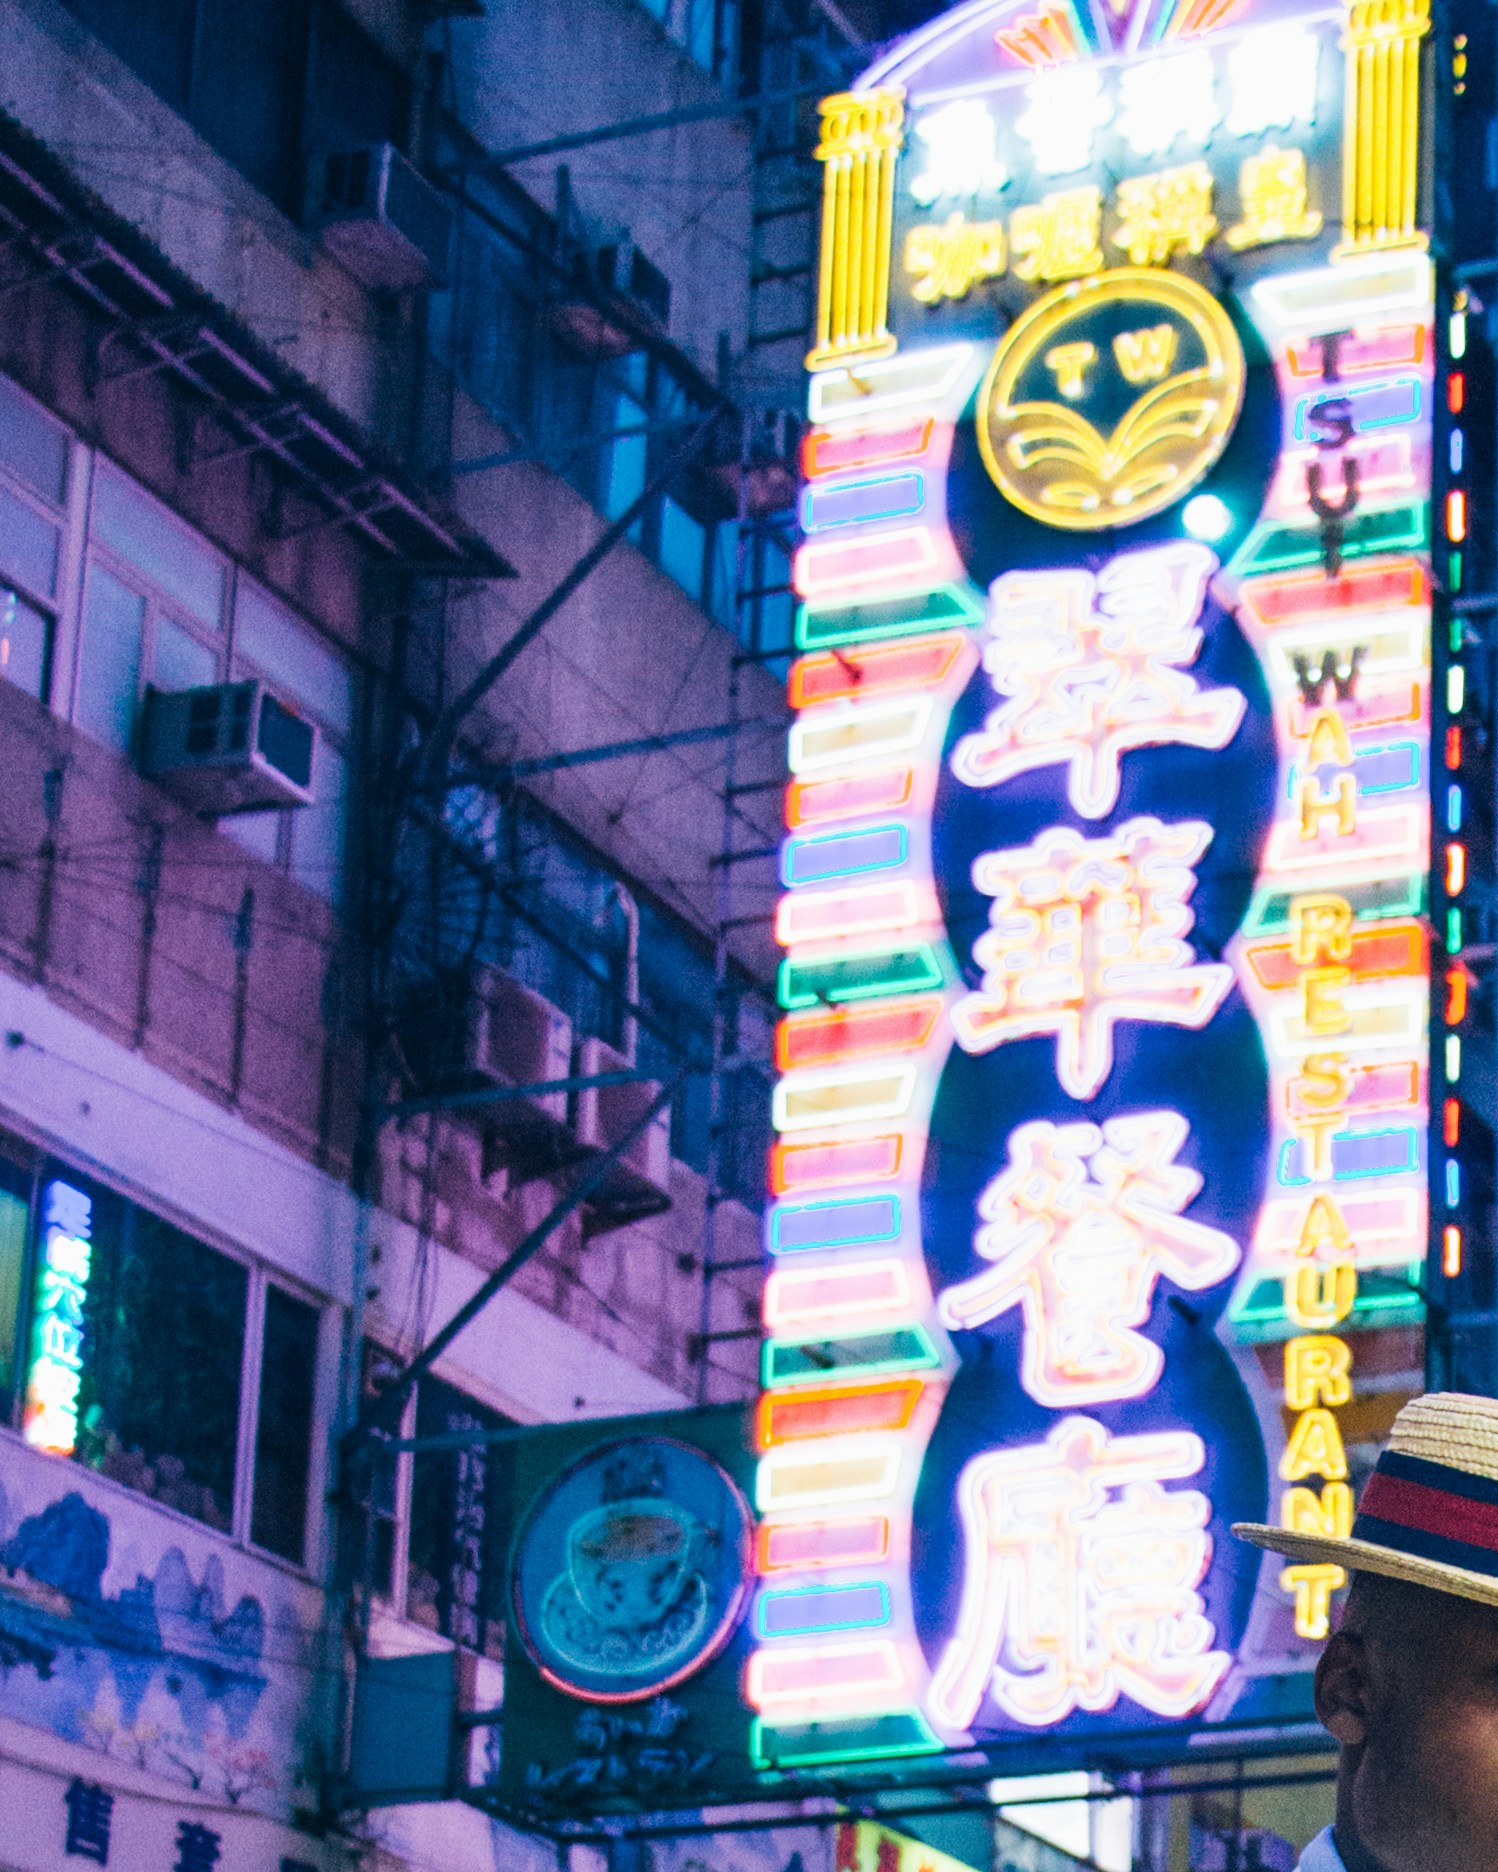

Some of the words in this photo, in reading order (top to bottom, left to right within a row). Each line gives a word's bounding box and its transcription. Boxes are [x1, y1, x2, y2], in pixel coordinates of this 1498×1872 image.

[1293, 645, 1367, 840] WAH
[929, 540, 1248, 1731] 翠華餐廳
[1280, 894, 1358, 1641] RESTAURANT
